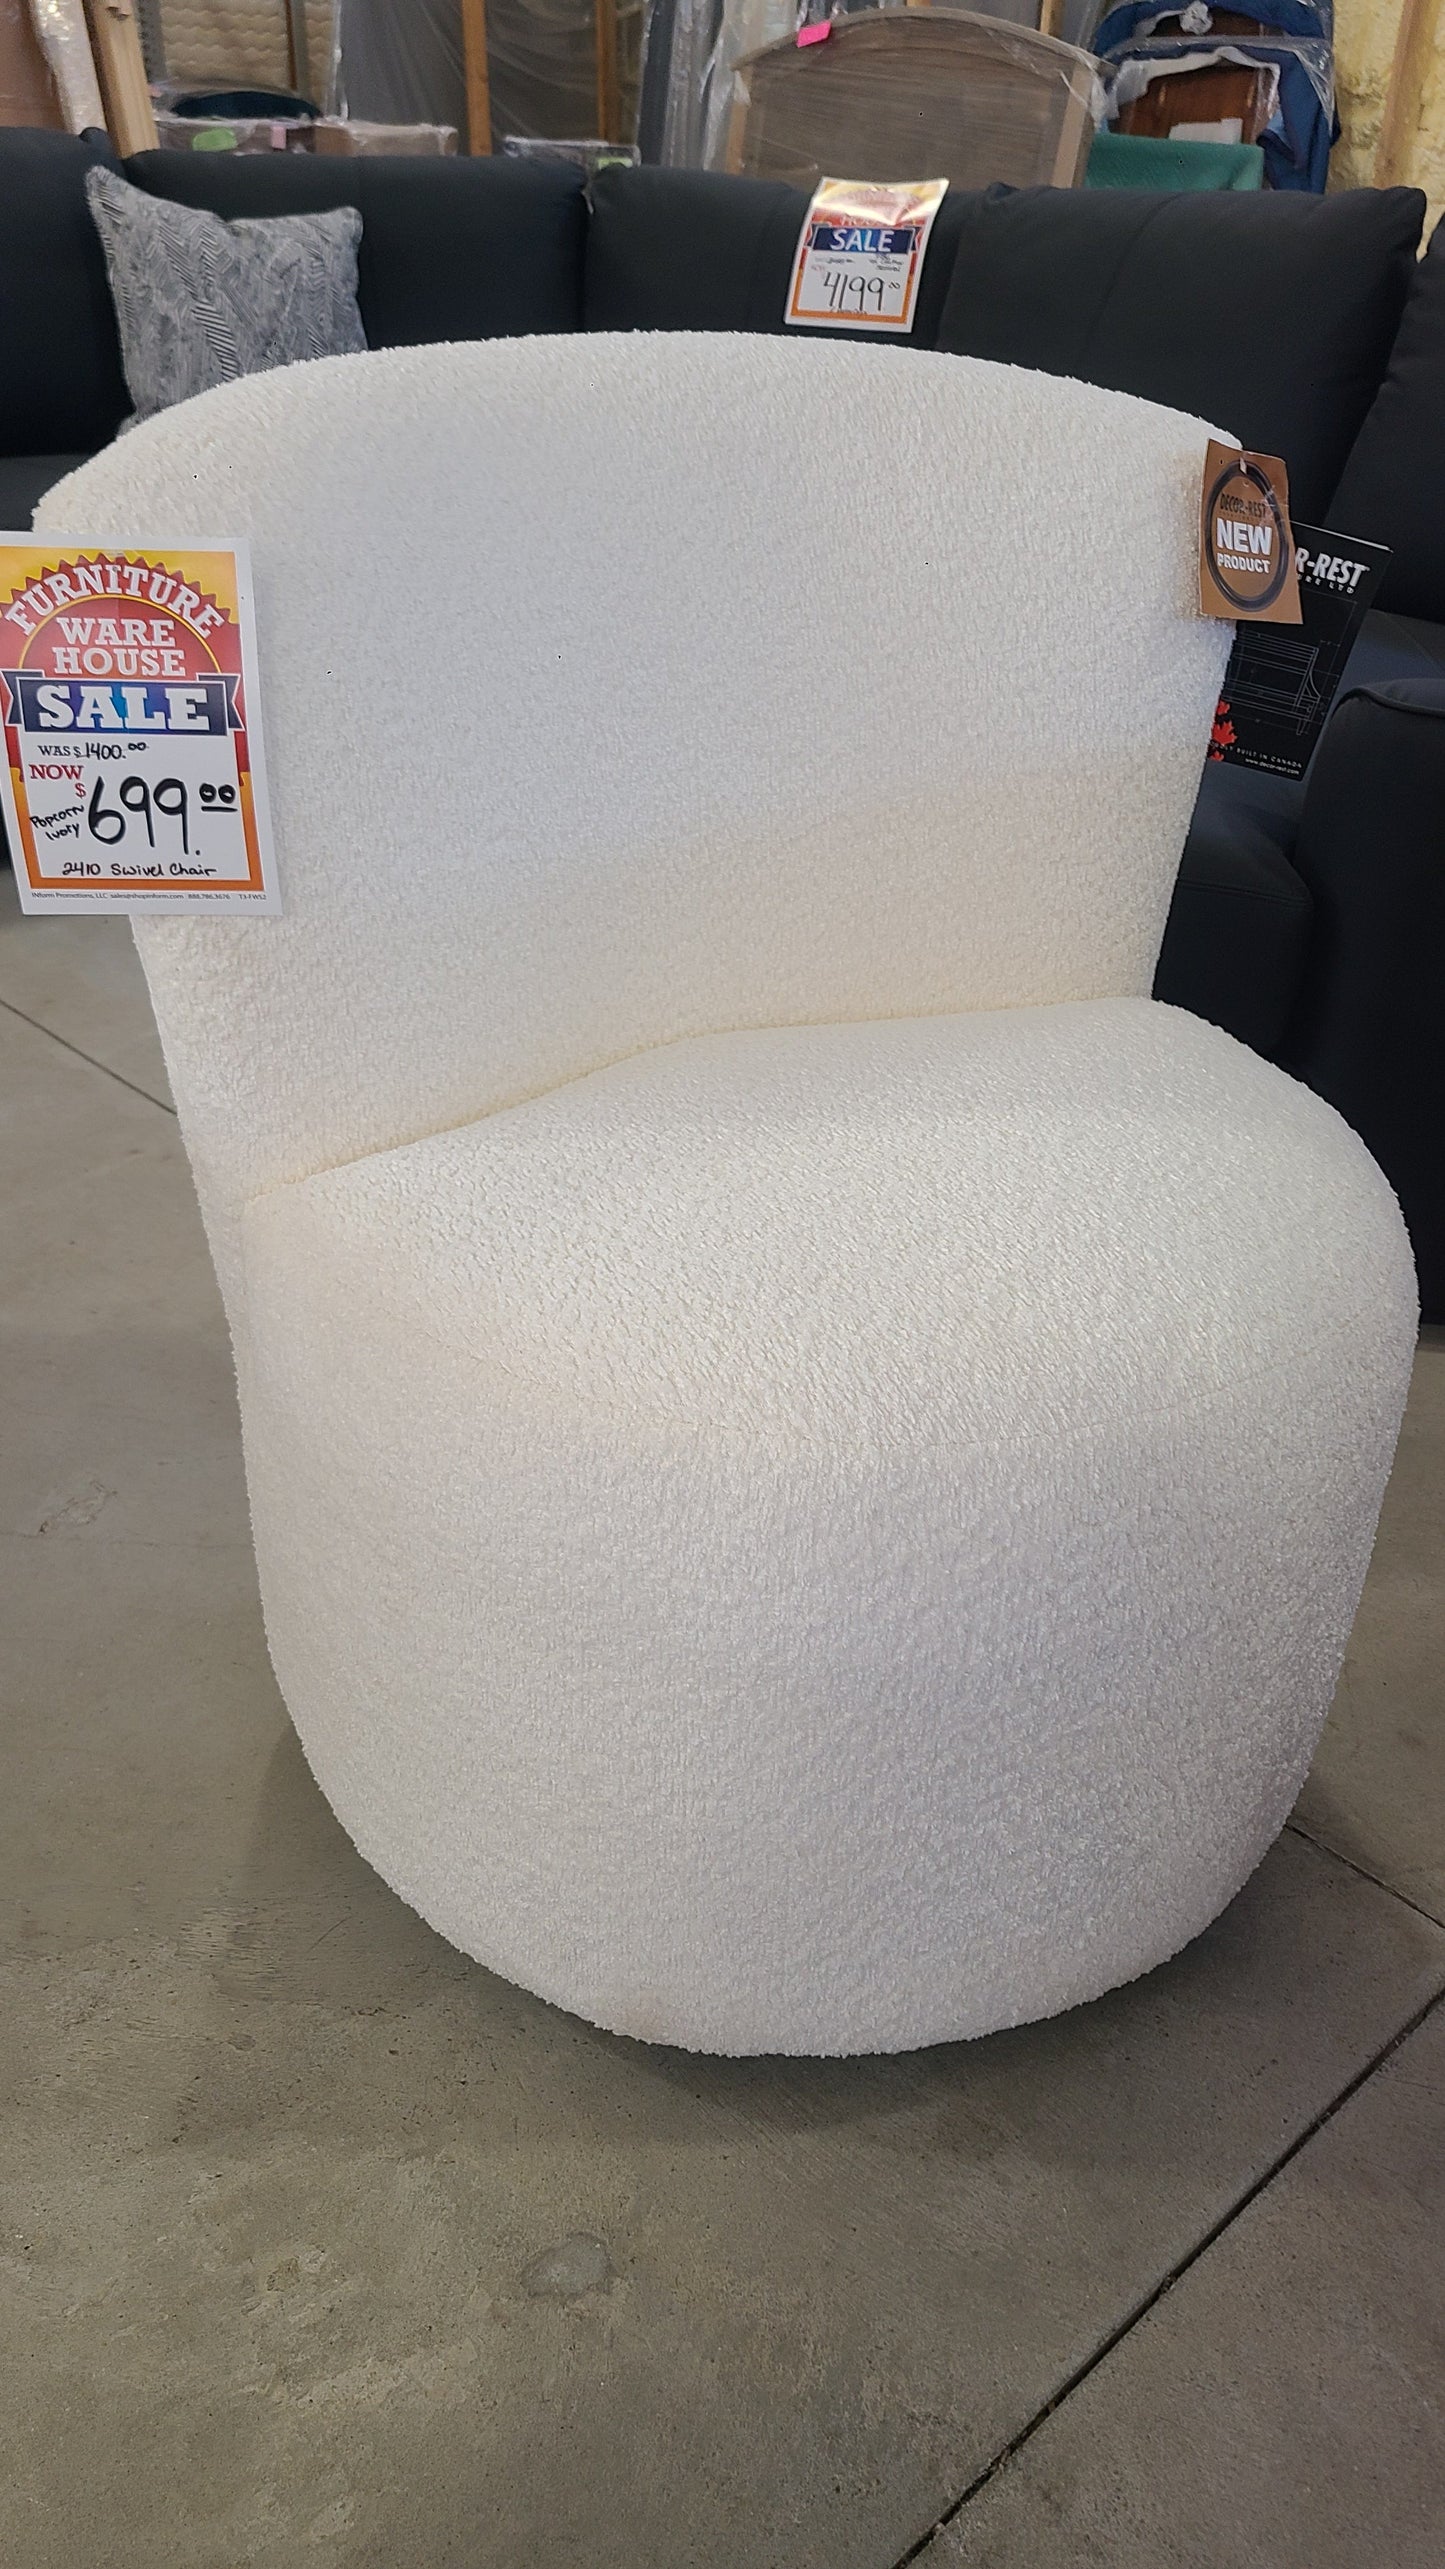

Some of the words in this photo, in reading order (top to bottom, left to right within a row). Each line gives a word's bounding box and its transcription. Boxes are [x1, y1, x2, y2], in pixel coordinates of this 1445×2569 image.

[829, 229, 894, 252] SALE
[1219, 493, 1267, 518] DECOR-REST
[1216, 517, 1273, 556] NEW
[1216, 552, 1271, 574] PRODUCT
[1295, 547, 1366, 588] R-REST
[4, 564, 225, 638] FURNITURE
[55, 617, 176, 648] WARE
[52, 647, 186, 677] HOUSE
[36, 685, 210, 731] SALE
[38, 744, 71, 757] WAS
[1270, 755, 1302, 769] CANADA
[29, 764, 84, 780] NOW
[74, 783, 87, 799] $
[29, 804, 85, 829] Popcorn
[62, 861, 100, 876] 2410
[110, 861, 164, 876] Swivel
[169, 861, 217, 877] Chair
